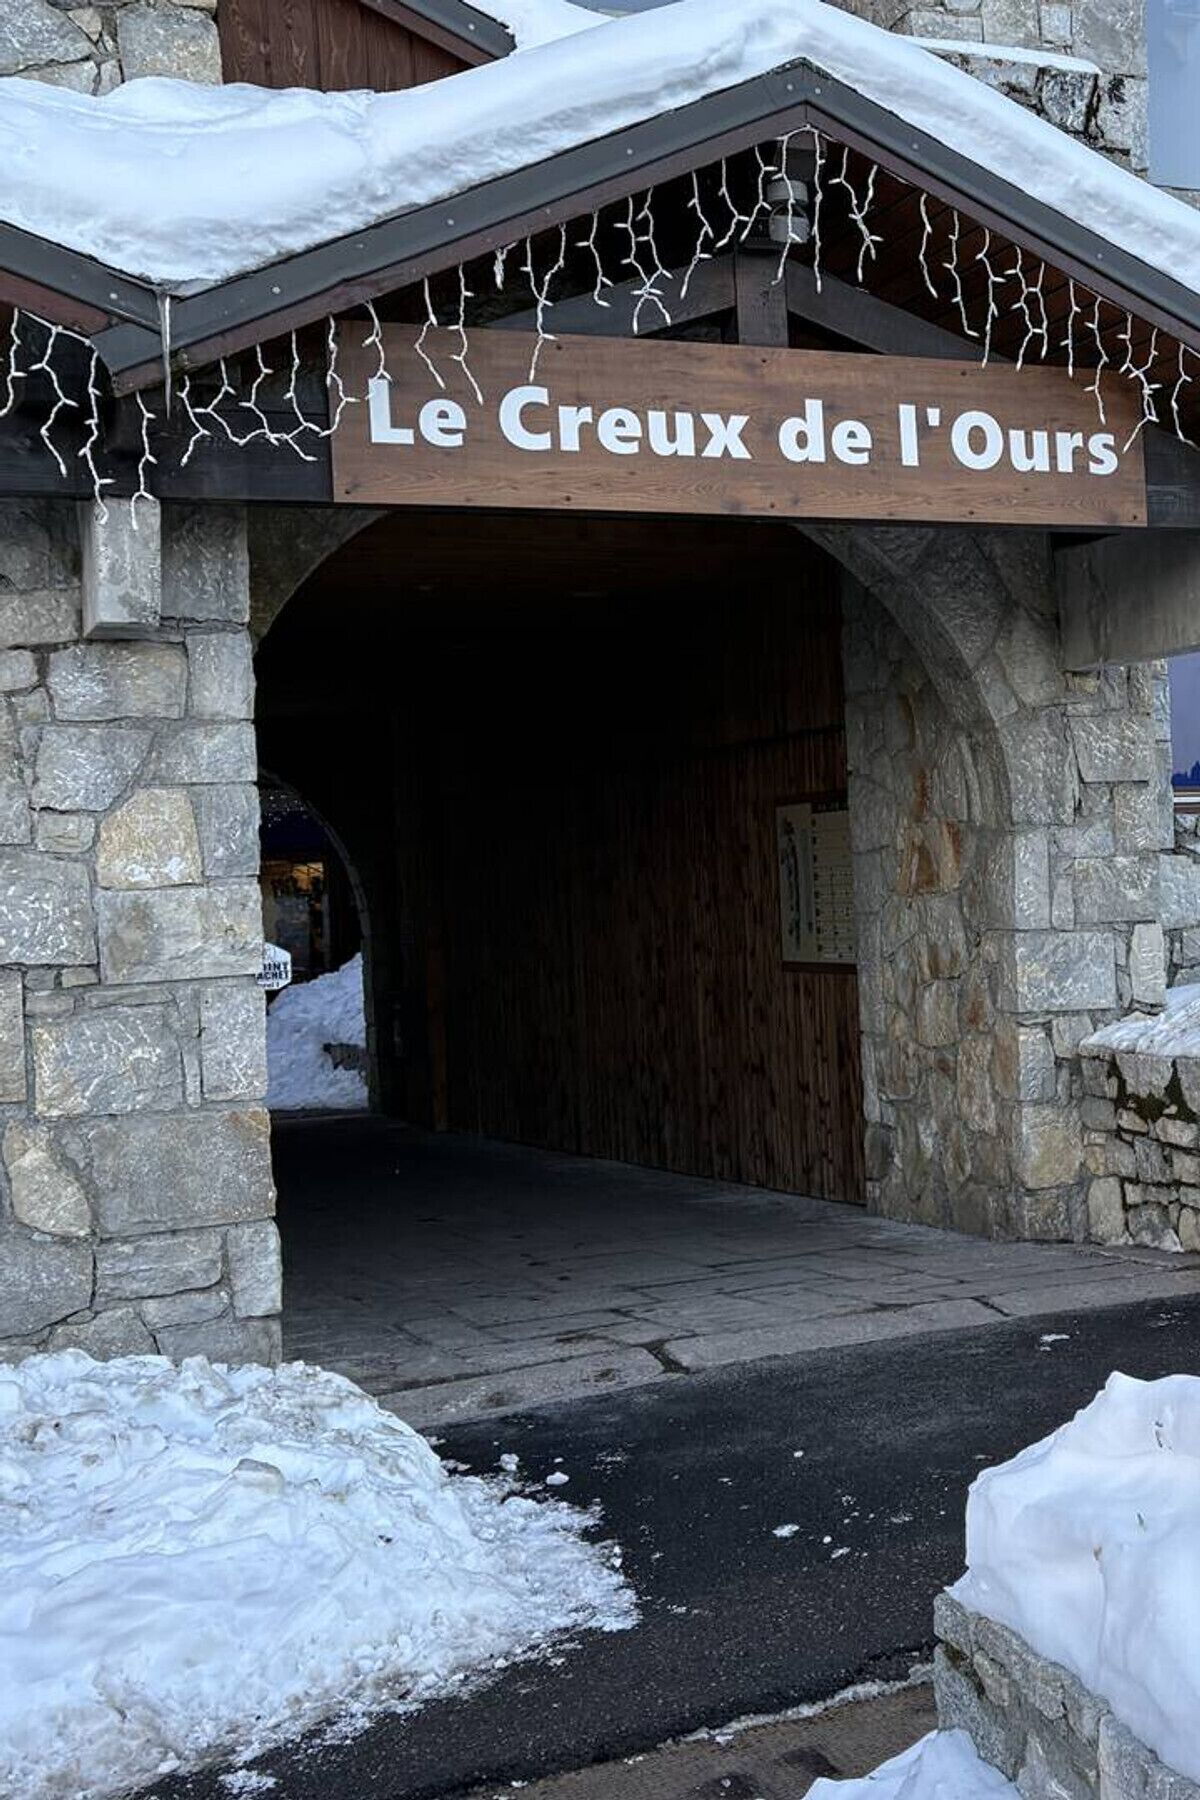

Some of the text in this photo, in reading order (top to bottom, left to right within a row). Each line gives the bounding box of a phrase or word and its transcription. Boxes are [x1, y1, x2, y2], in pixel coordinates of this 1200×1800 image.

[368, 378, 1119, 476] Le Creux de l'Ours
